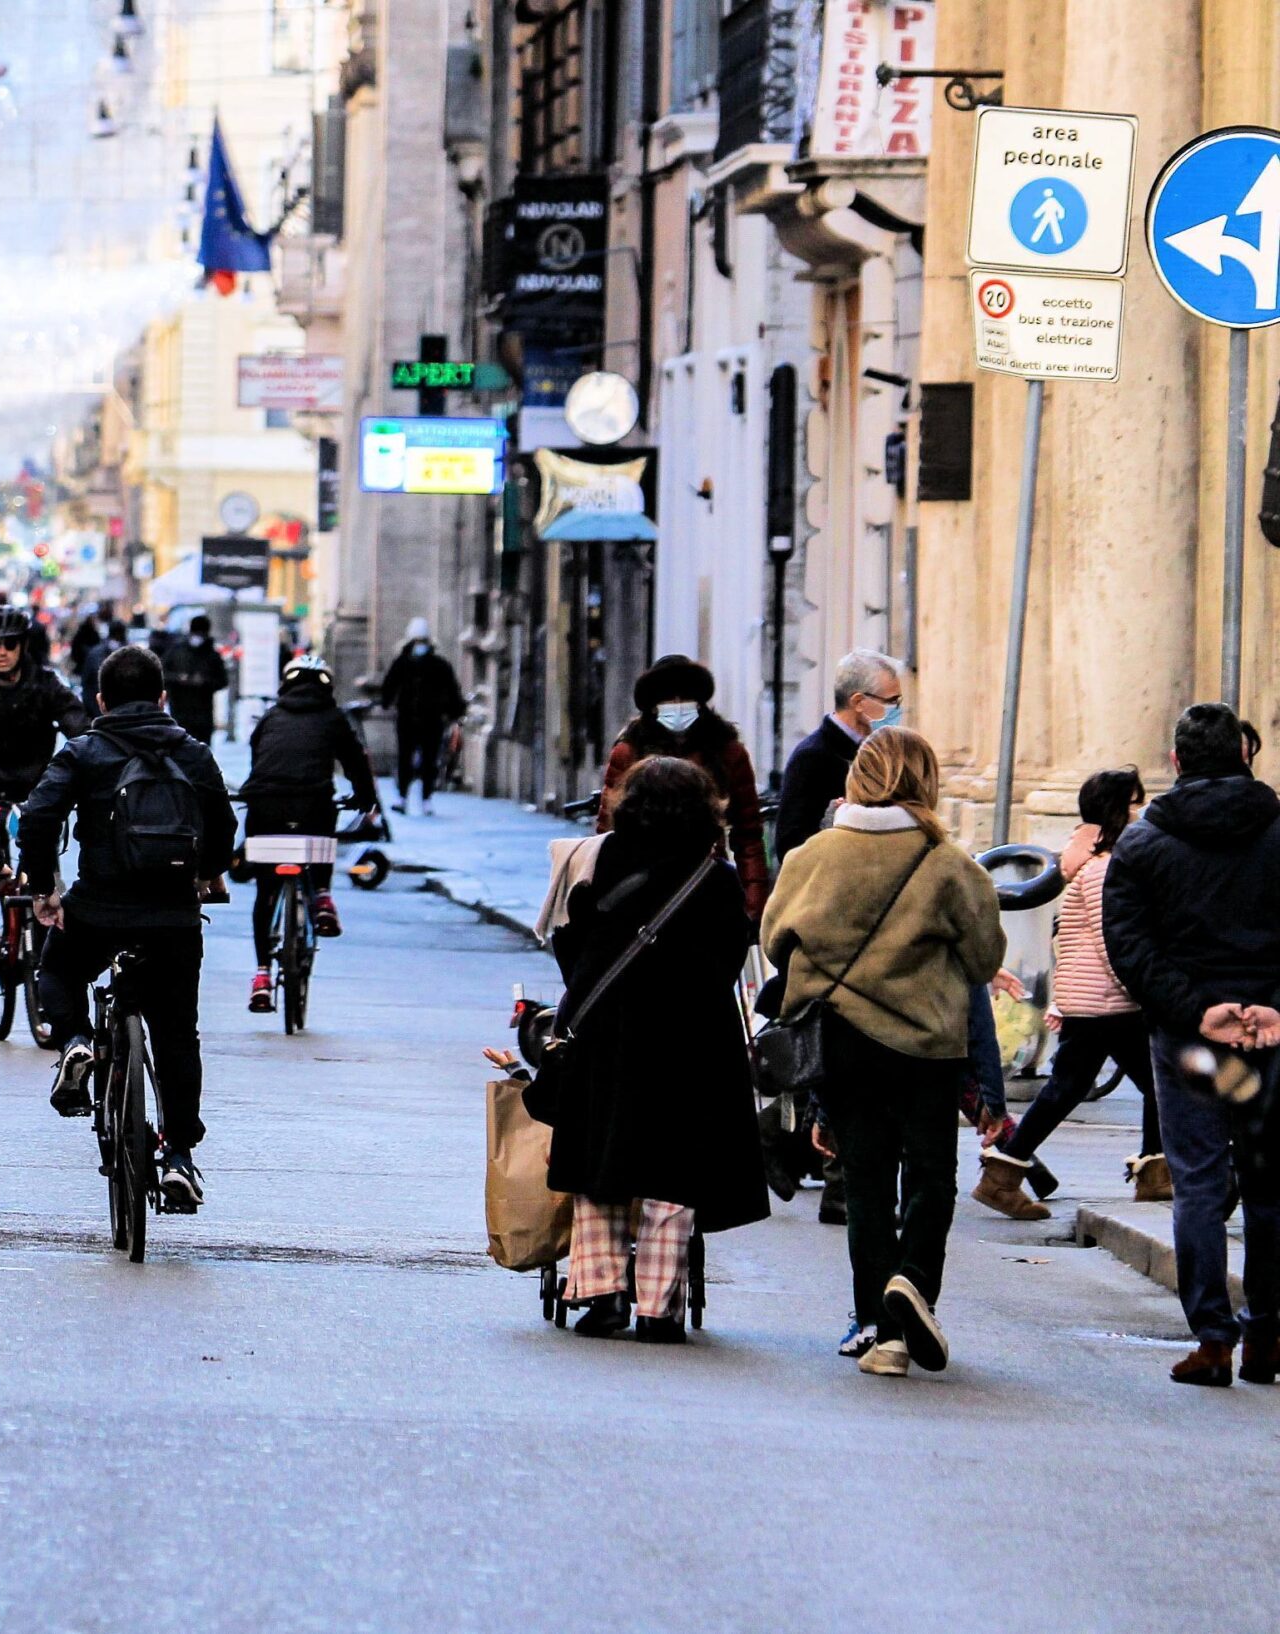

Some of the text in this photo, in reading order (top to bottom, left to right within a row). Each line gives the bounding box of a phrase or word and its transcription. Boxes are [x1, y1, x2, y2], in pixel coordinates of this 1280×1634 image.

[834, 0, 868, 153] RISTORANTE
[886, 6, 926, 153] PIZZA
[1032, 126, 1079, 142] area
[1004, 149, 1104, 170] pedonale
[986, 290, 1006, 308] 20
[1042, 297, 1093, 310] eccetto
[1018, 314, 1115, 329] bus a trazione
[1036, 333, 1093, 346] elettrica
[979, 354, 1114, 374] veicoli diretti aree interne
